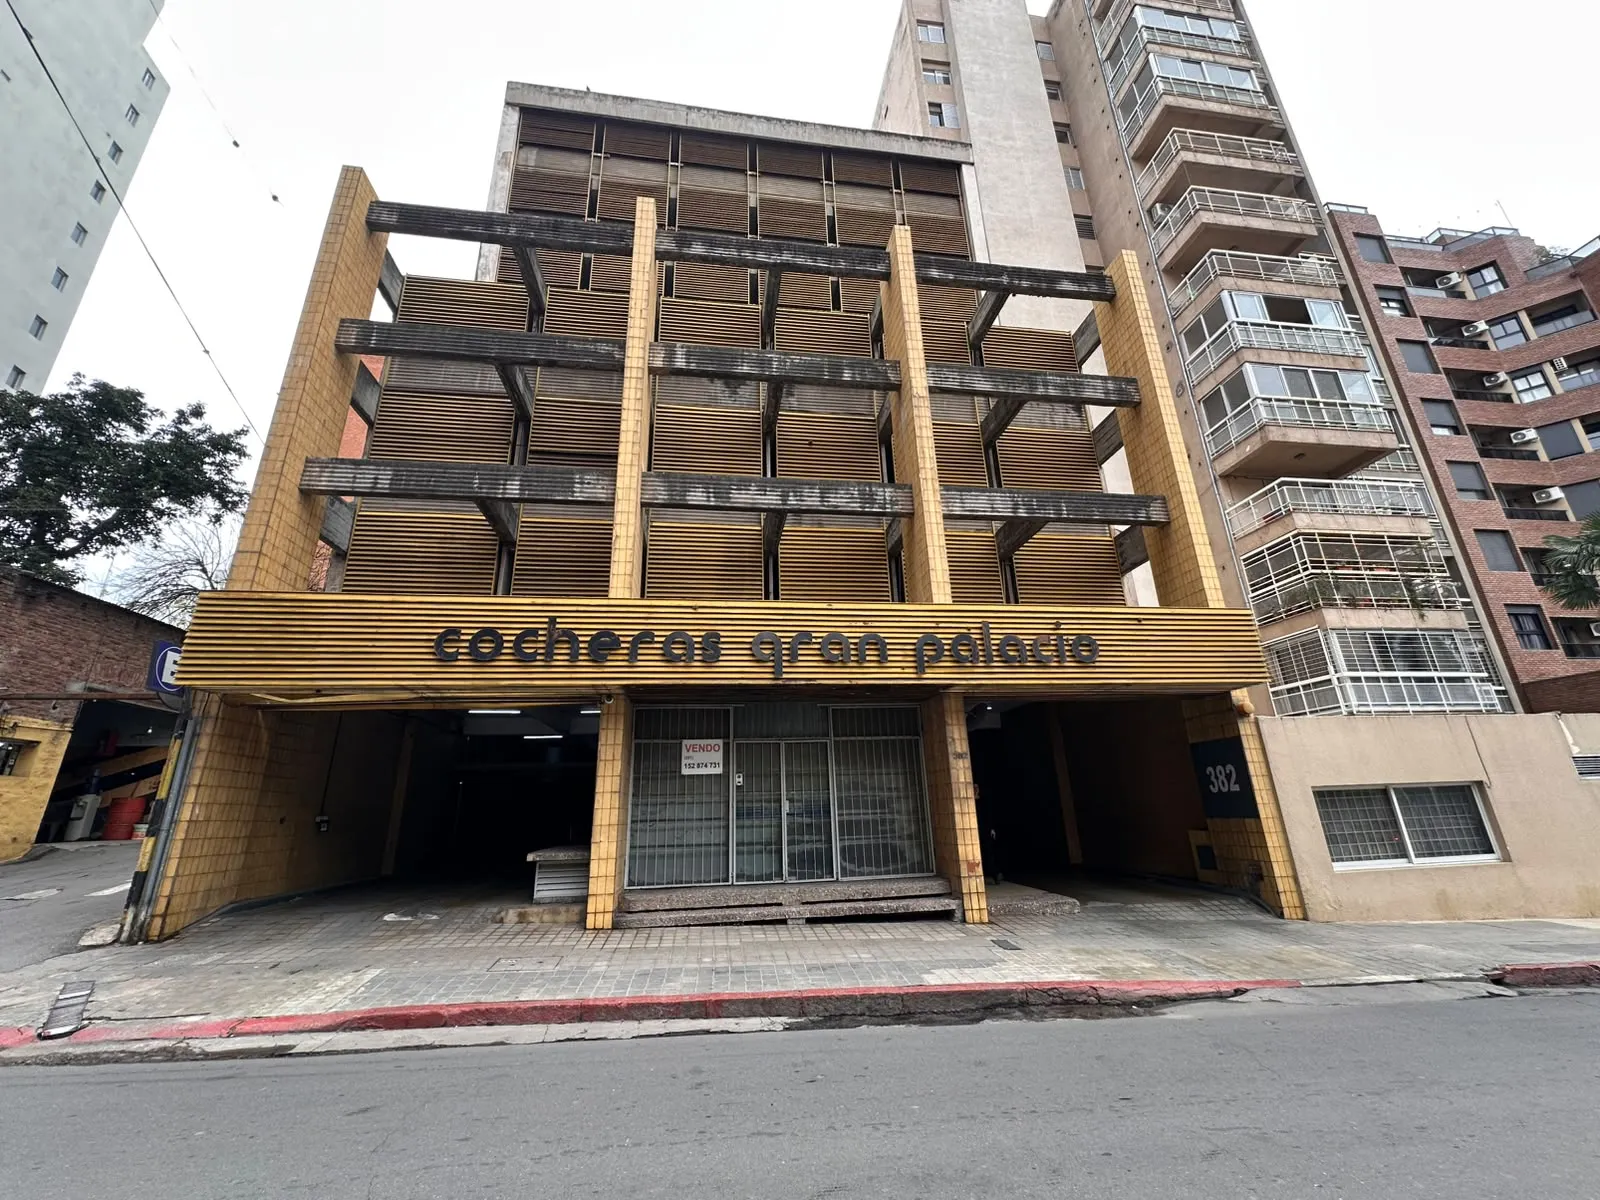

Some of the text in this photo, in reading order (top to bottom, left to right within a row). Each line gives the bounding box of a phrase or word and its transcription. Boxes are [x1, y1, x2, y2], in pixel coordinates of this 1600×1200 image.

[434, 616, 722, 663] cocheras
[915, 620, 1101, 676] palacio
[685, 743, 721, 753] VENDO
[709, 761, 721, 769] 731
[1206, 764, 1240, 793] 382
